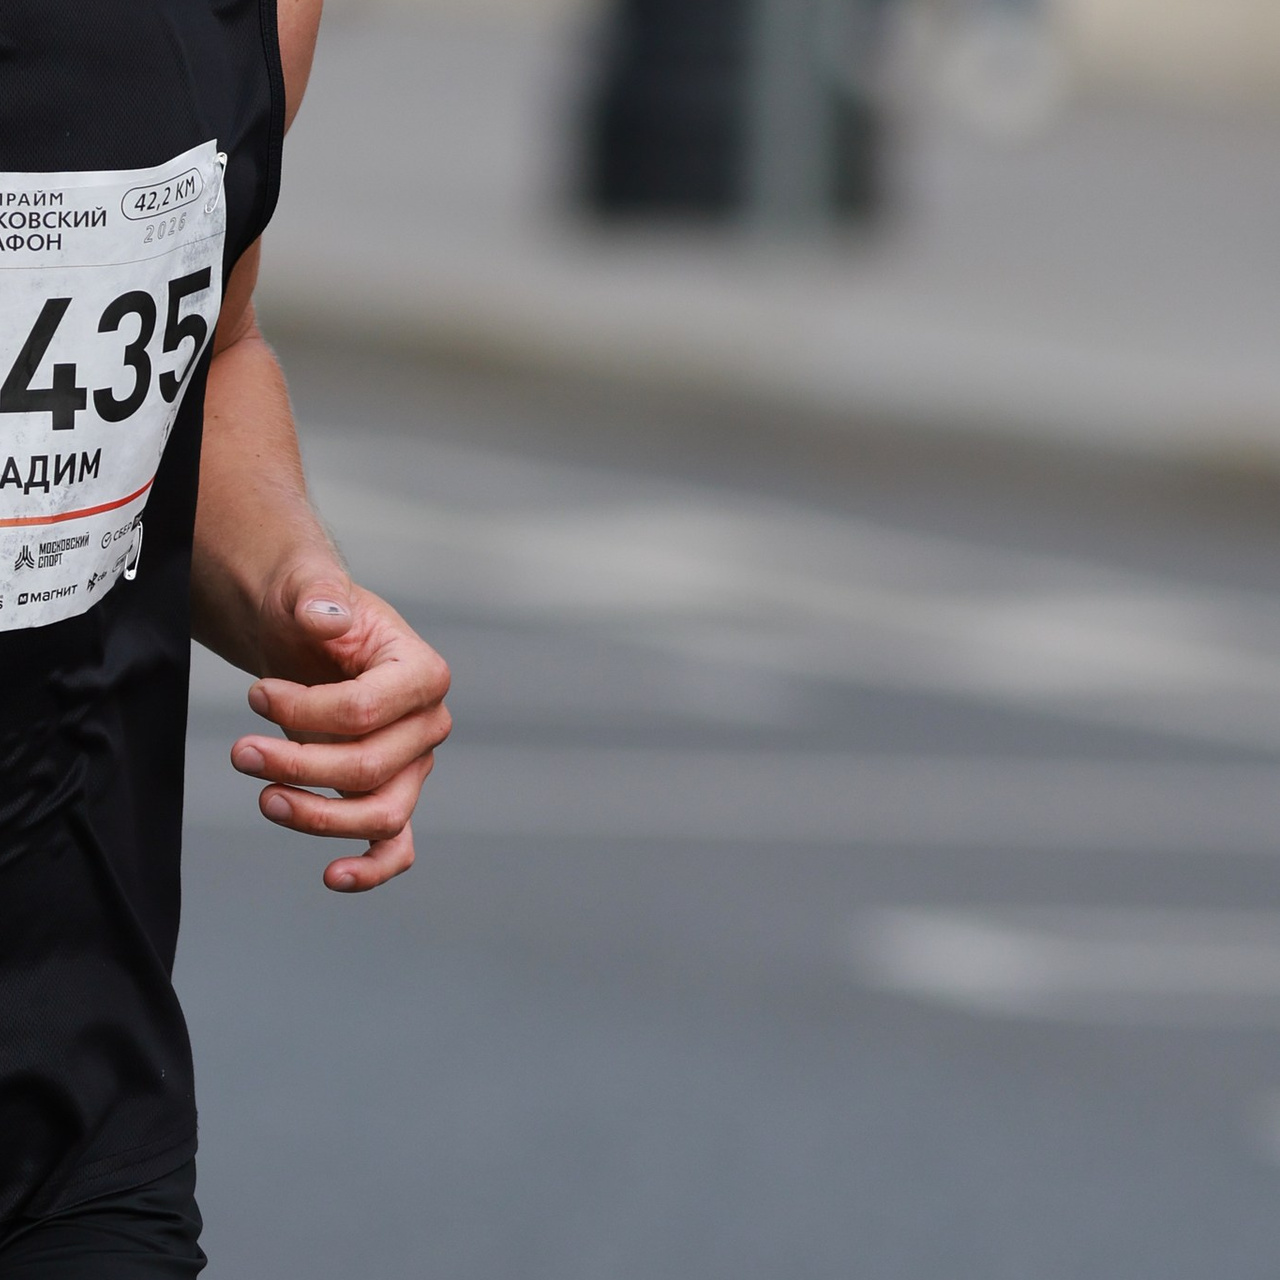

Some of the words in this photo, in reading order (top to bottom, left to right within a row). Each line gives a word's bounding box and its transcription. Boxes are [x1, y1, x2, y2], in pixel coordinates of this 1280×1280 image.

[134, 186, 171, 211] 42,2
[175, 176, 195, 201] КМ
[39, 532, 90, 555] МОСКОВСКИЙ
[38, 553, 63, 568] СПОРТ
[30, 584, 78, 603] магнит
